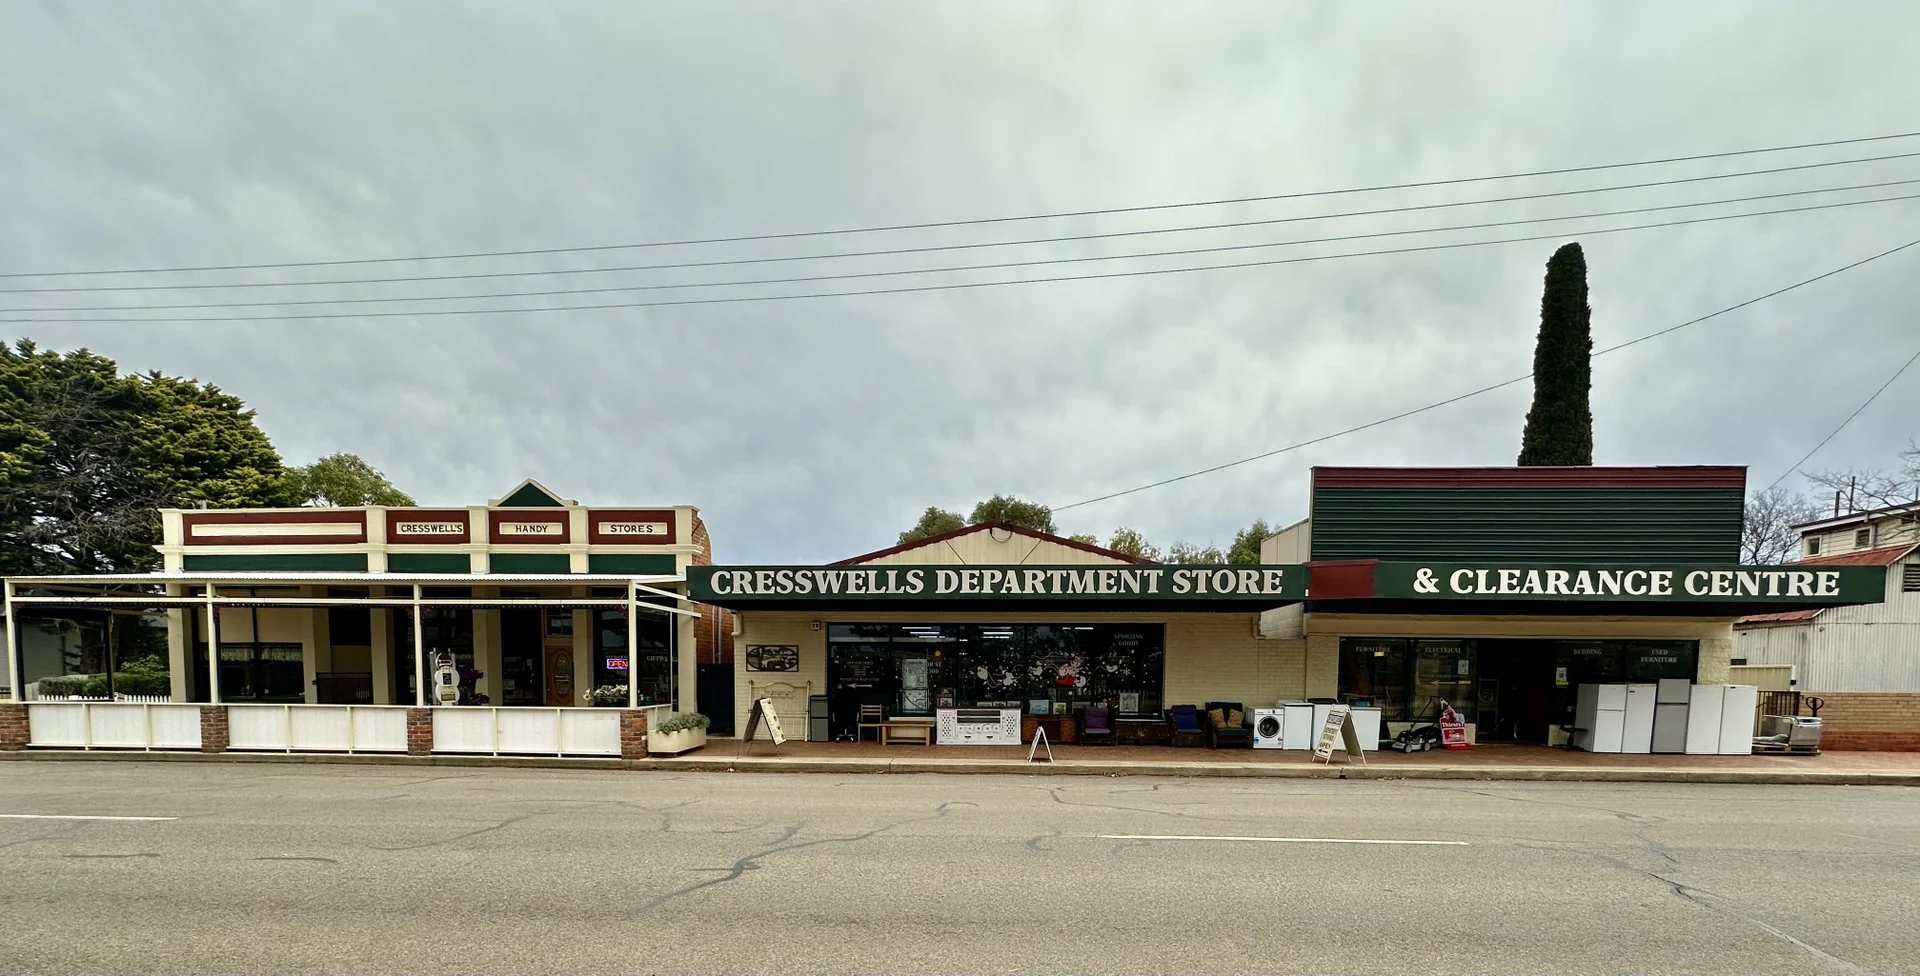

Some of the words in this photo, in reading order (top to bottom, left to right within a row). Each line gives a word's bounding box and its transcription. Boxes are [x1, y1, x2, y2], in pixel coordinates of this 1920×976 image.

[400, 524, 463, 533] CRESSWELL'S
[515, 524, 549, 533] HANDY
[610, 524, 653, 533] STORES
[710, 569, 924, 595] CRESSWELLS
[935, 569, 1164, 594] DEPARTMENT
[1172, 569, 1284, 594] STORE
[1413, 568, 1440, 594] &
[1449, 568, 1673, 596] CLEARANCE
[1684, 570, 1840, 597] CENTRE
